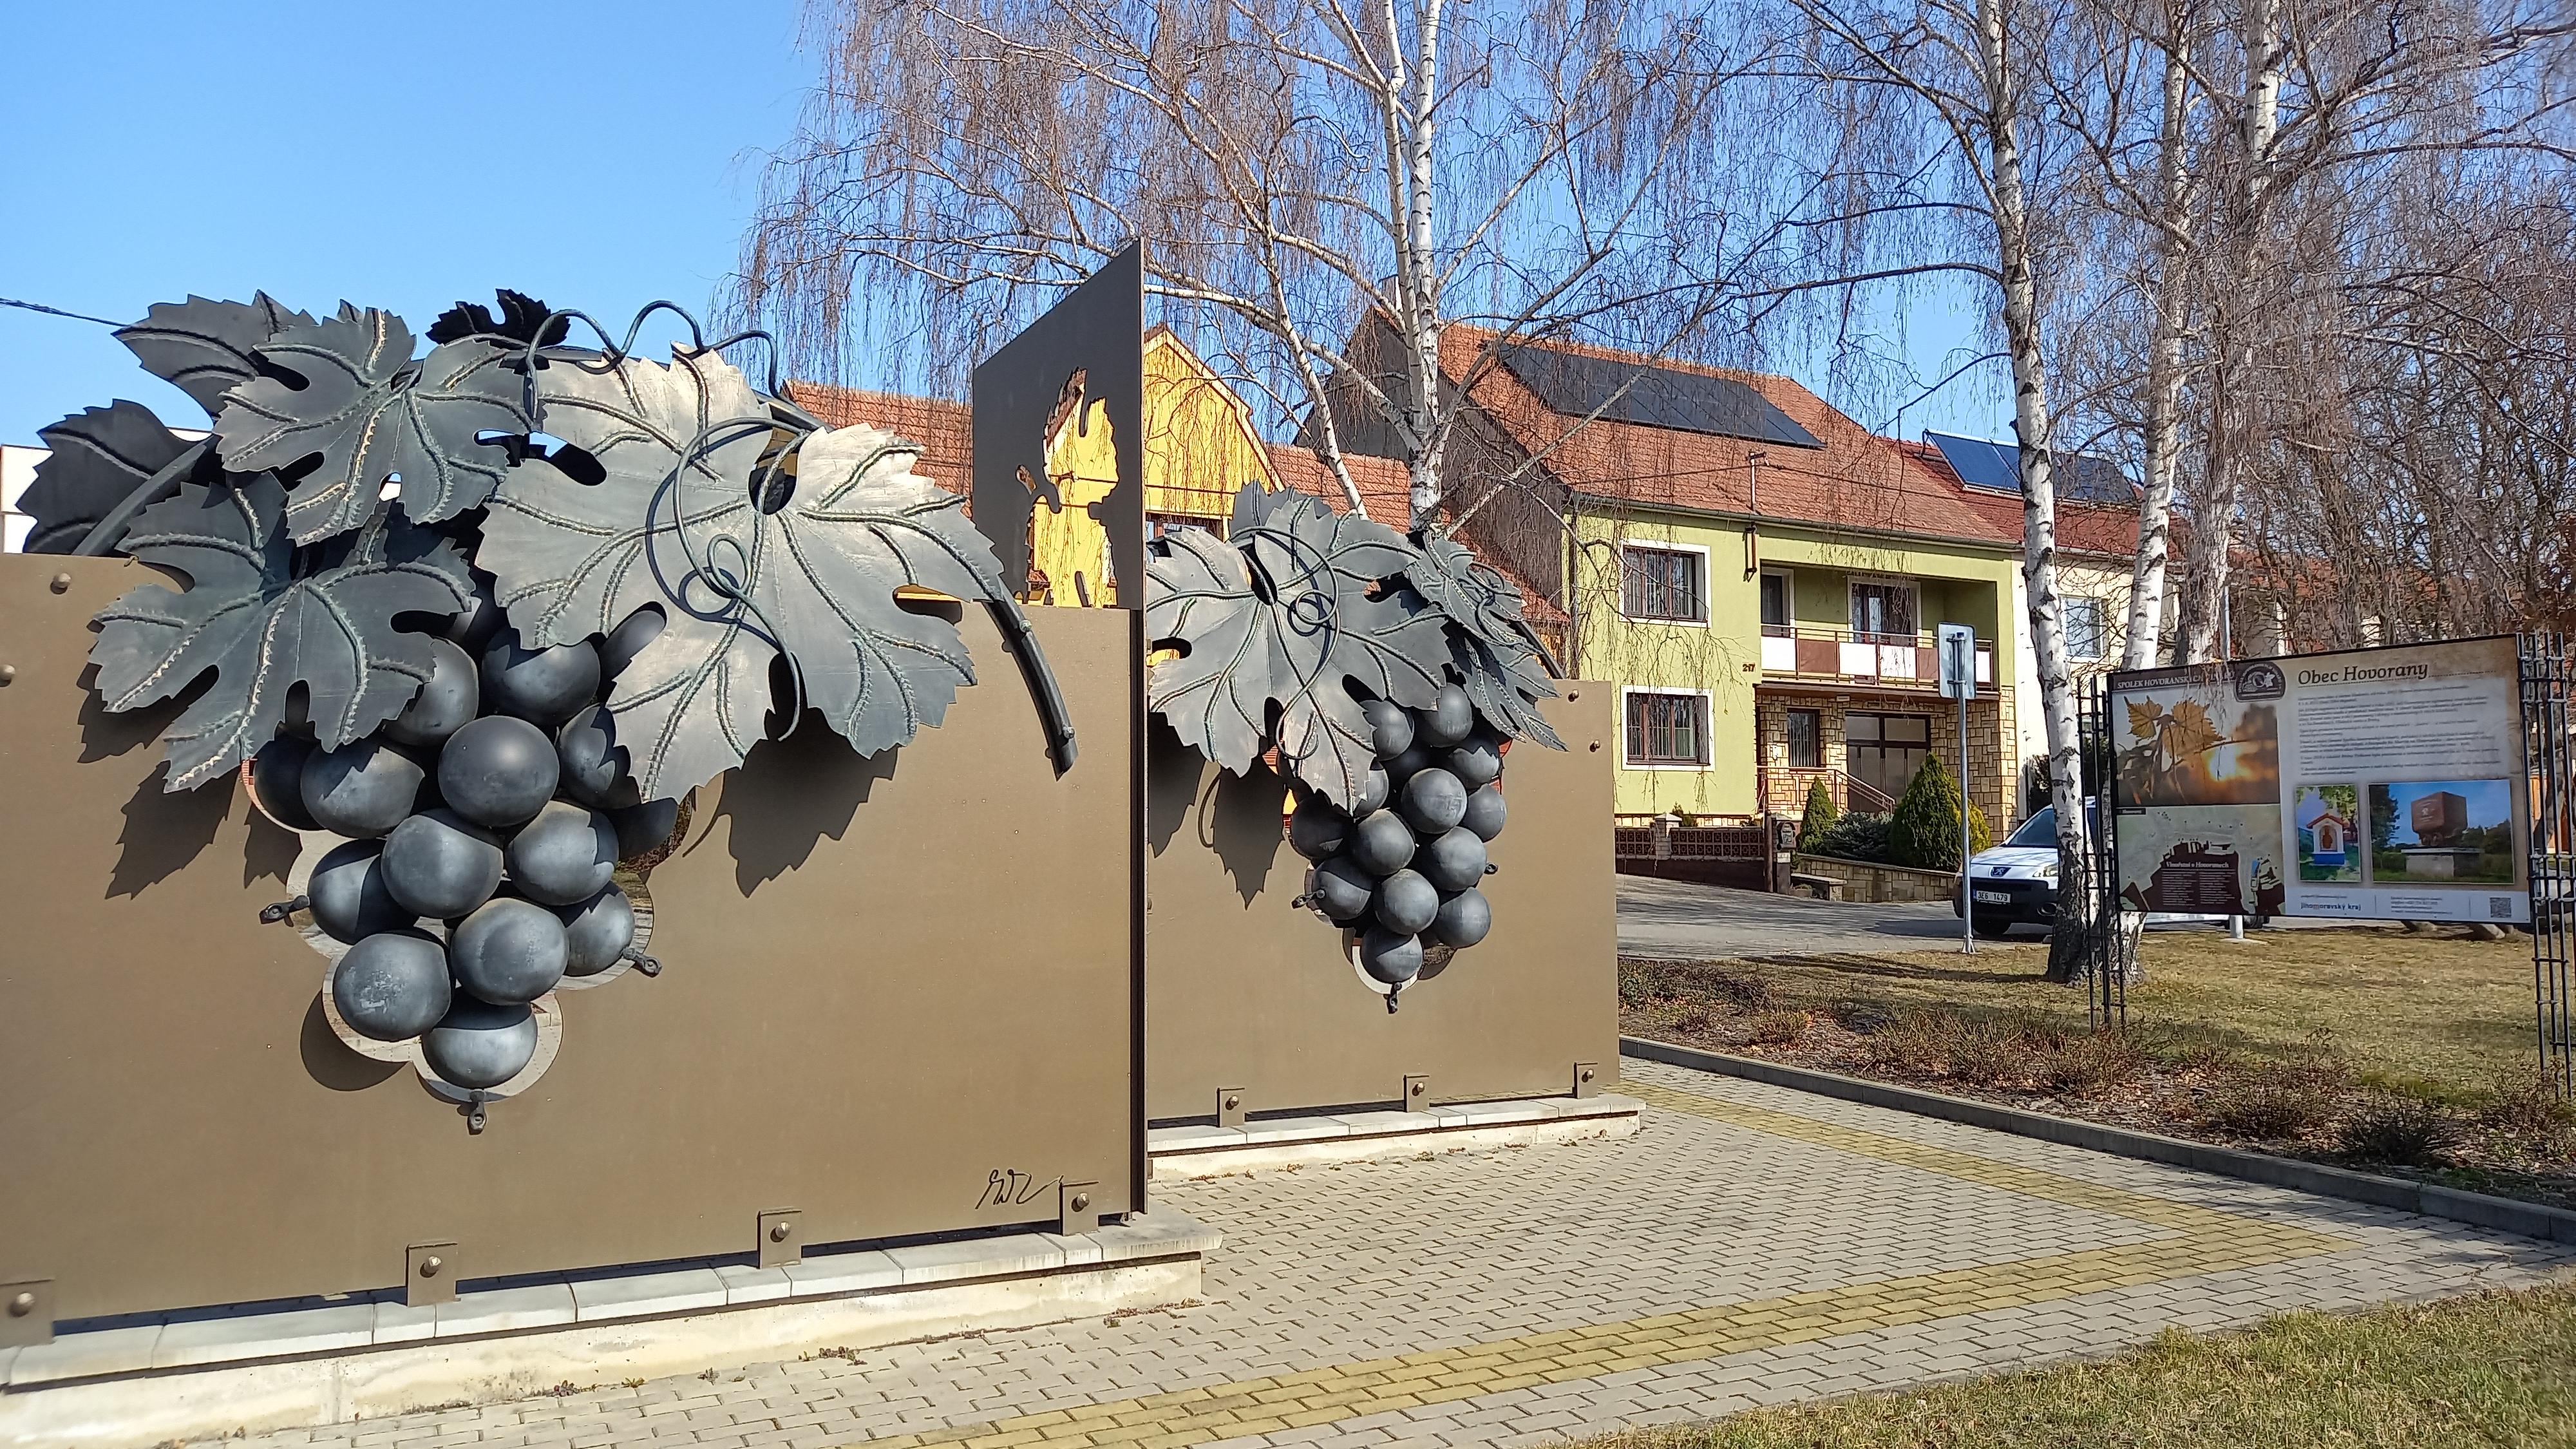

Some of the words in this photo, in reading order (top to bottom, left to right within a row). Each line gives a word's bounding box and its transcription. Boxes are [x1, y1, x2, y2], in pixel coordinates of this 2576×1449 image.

[1742, 663, 1756, 672] 217
[2298, 670, 2339, 685] Obec
[2342, 663, 2429, 681] Hovorany
[2117, 680, 2144, 689] SPOLEK
[1978, 891, 1989, 900] 3E6
[1993, 893, 2008, 902] 1479
[2300, 902, 2345, 911] jihomoravský
[2347, 903, 2362, 911] kraj
